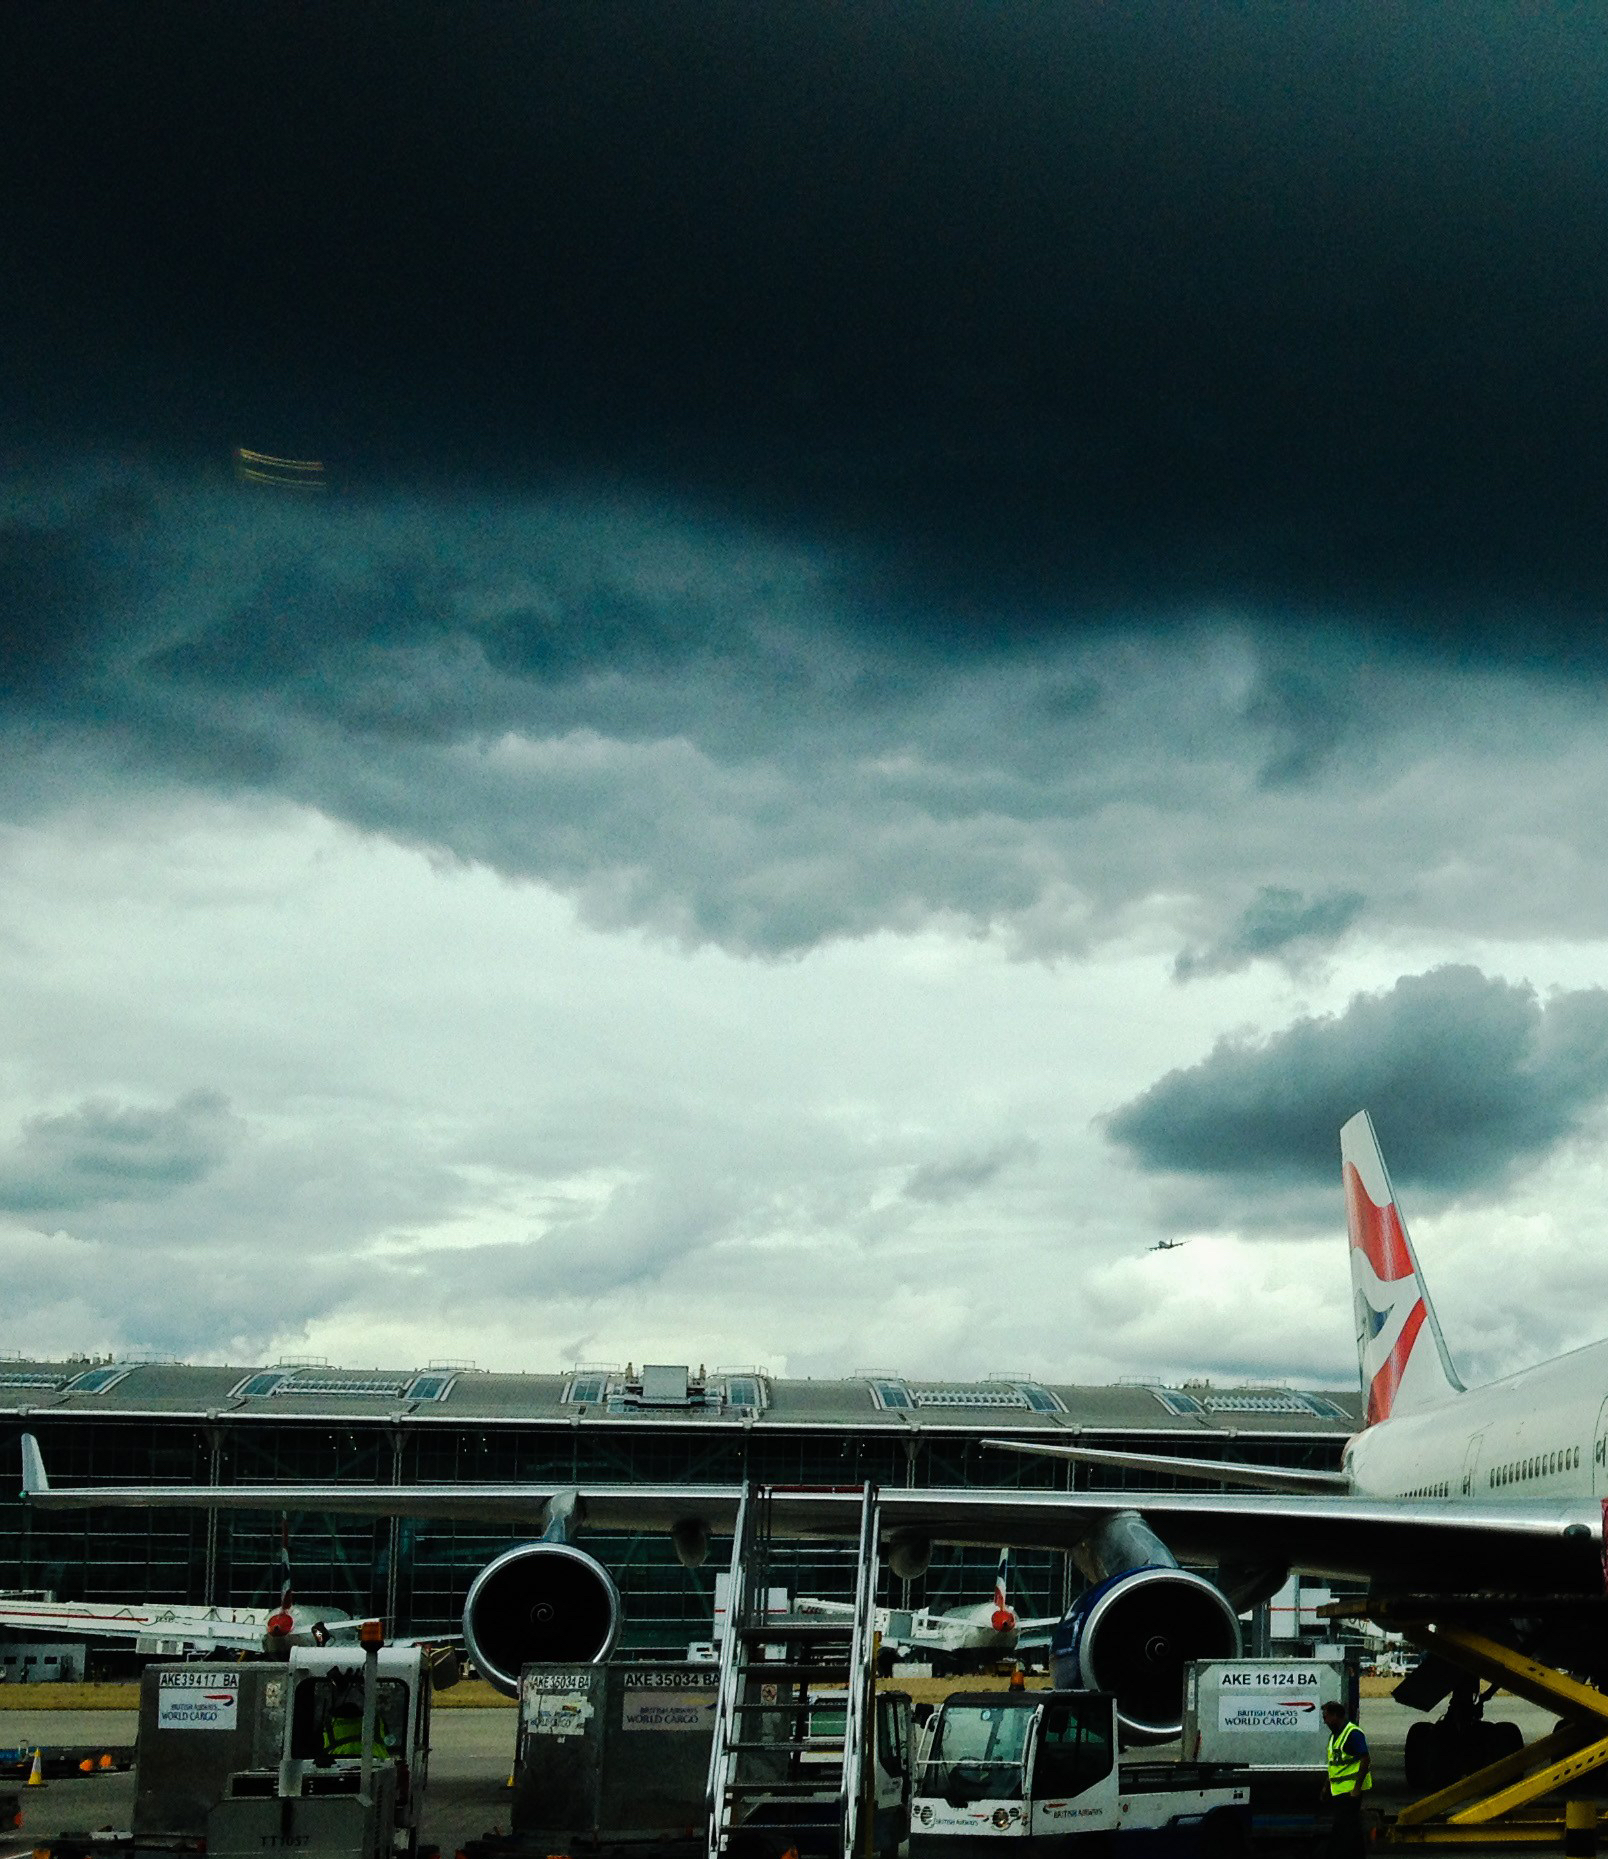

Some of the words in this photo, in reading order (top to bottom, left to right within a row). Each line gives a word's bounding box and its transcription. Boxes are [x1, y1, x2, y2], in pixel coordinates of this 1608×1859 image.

[223, 1673, 238, 1687] BA
[625, 1673, 654, 1686] AKE
[655, 1673, 699, 1686] 35034
[703, 1673, 720, 1686] BA
[1221, 1673, 1252, 1685] AKE
[1255, 1673, 1295, 1685] 16124
[1297, 1673, 1318, 1685] BA
[161, 1711, 189, 1721] WORLD
[190, 1711, 217, 1721] CARGO
[626, 1714, 663, 1724] WORLD
[664, 1714, 699, 1724] CARGO
[1225, 1717, 1260, 1726] WORLD
[1262, 1717, 1298, 1726] CARGO
